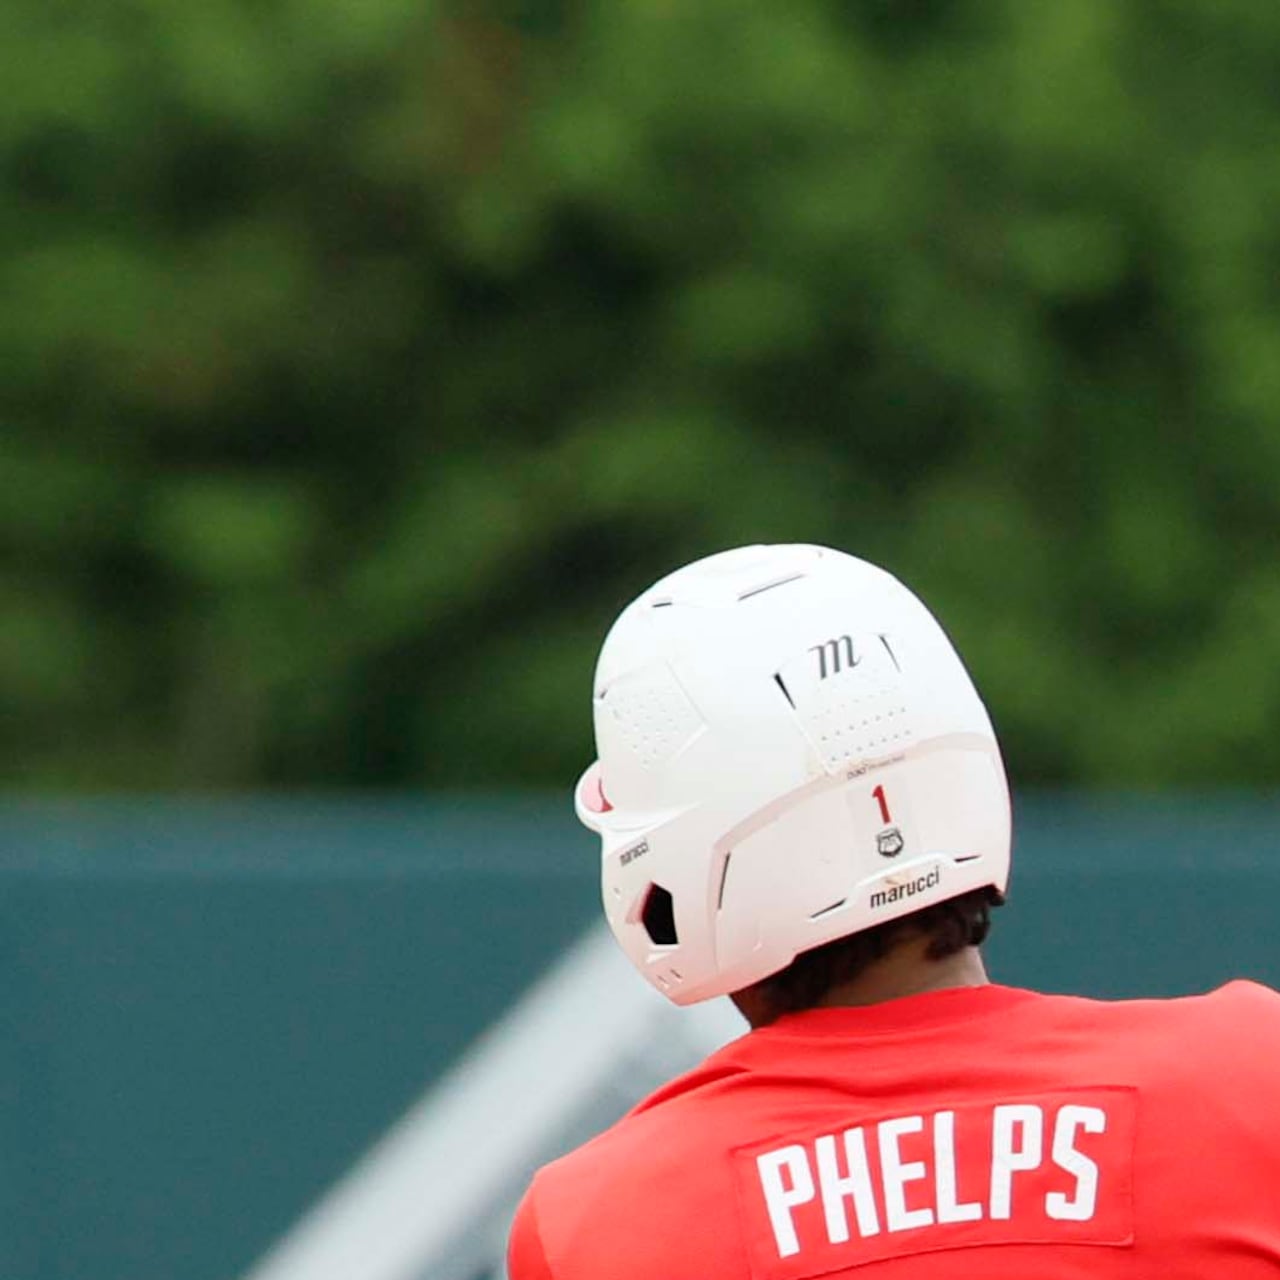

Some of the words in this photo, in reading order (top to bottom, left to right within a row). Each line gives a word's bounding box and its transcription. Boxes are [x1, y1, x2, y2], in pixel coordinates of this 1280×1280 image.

[872, 784, 891, 824] 1
[870, 865, 939, 908] marucci
[756, 1104, 1106, 1259] PHELPS
